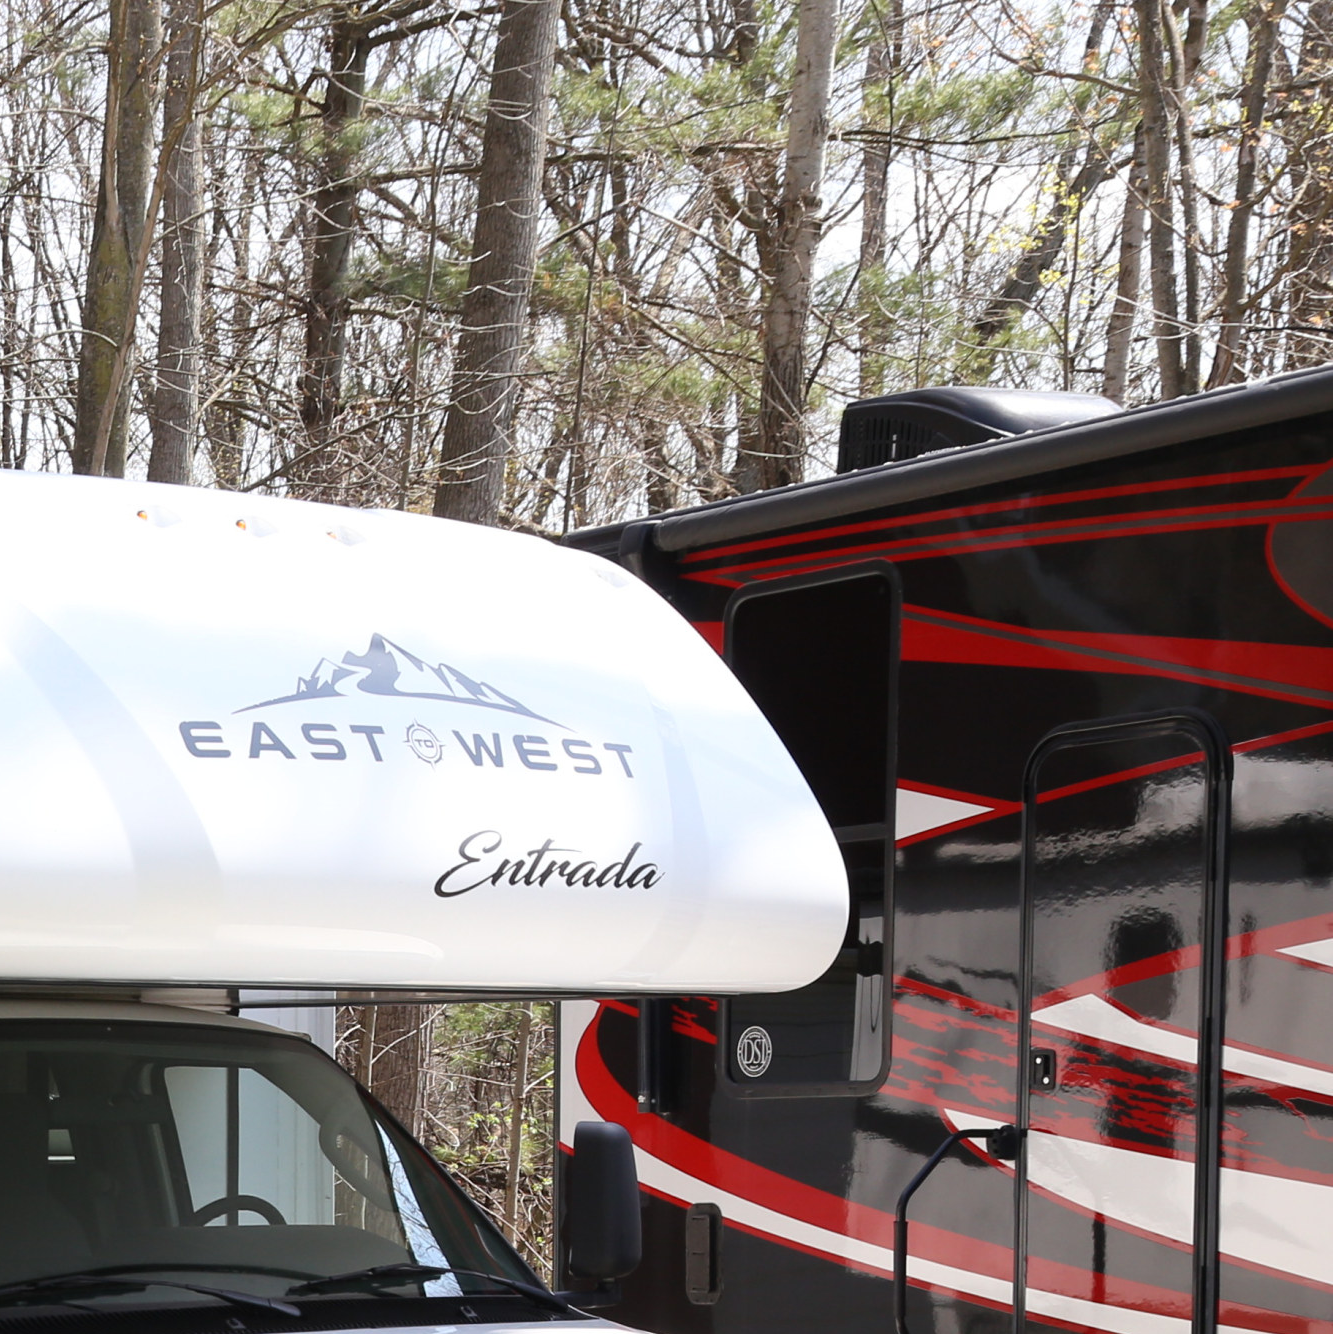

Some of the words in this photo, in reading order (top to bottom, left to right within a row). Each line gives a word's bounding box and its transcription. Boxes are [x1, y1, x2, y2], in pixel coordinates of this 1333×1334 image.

[179, 720, 386, 763] EAST
[414, 738, 434, 748] TO
[452, 729, 635, 779] WEST
[433, 829, 667, 899] Entrada
